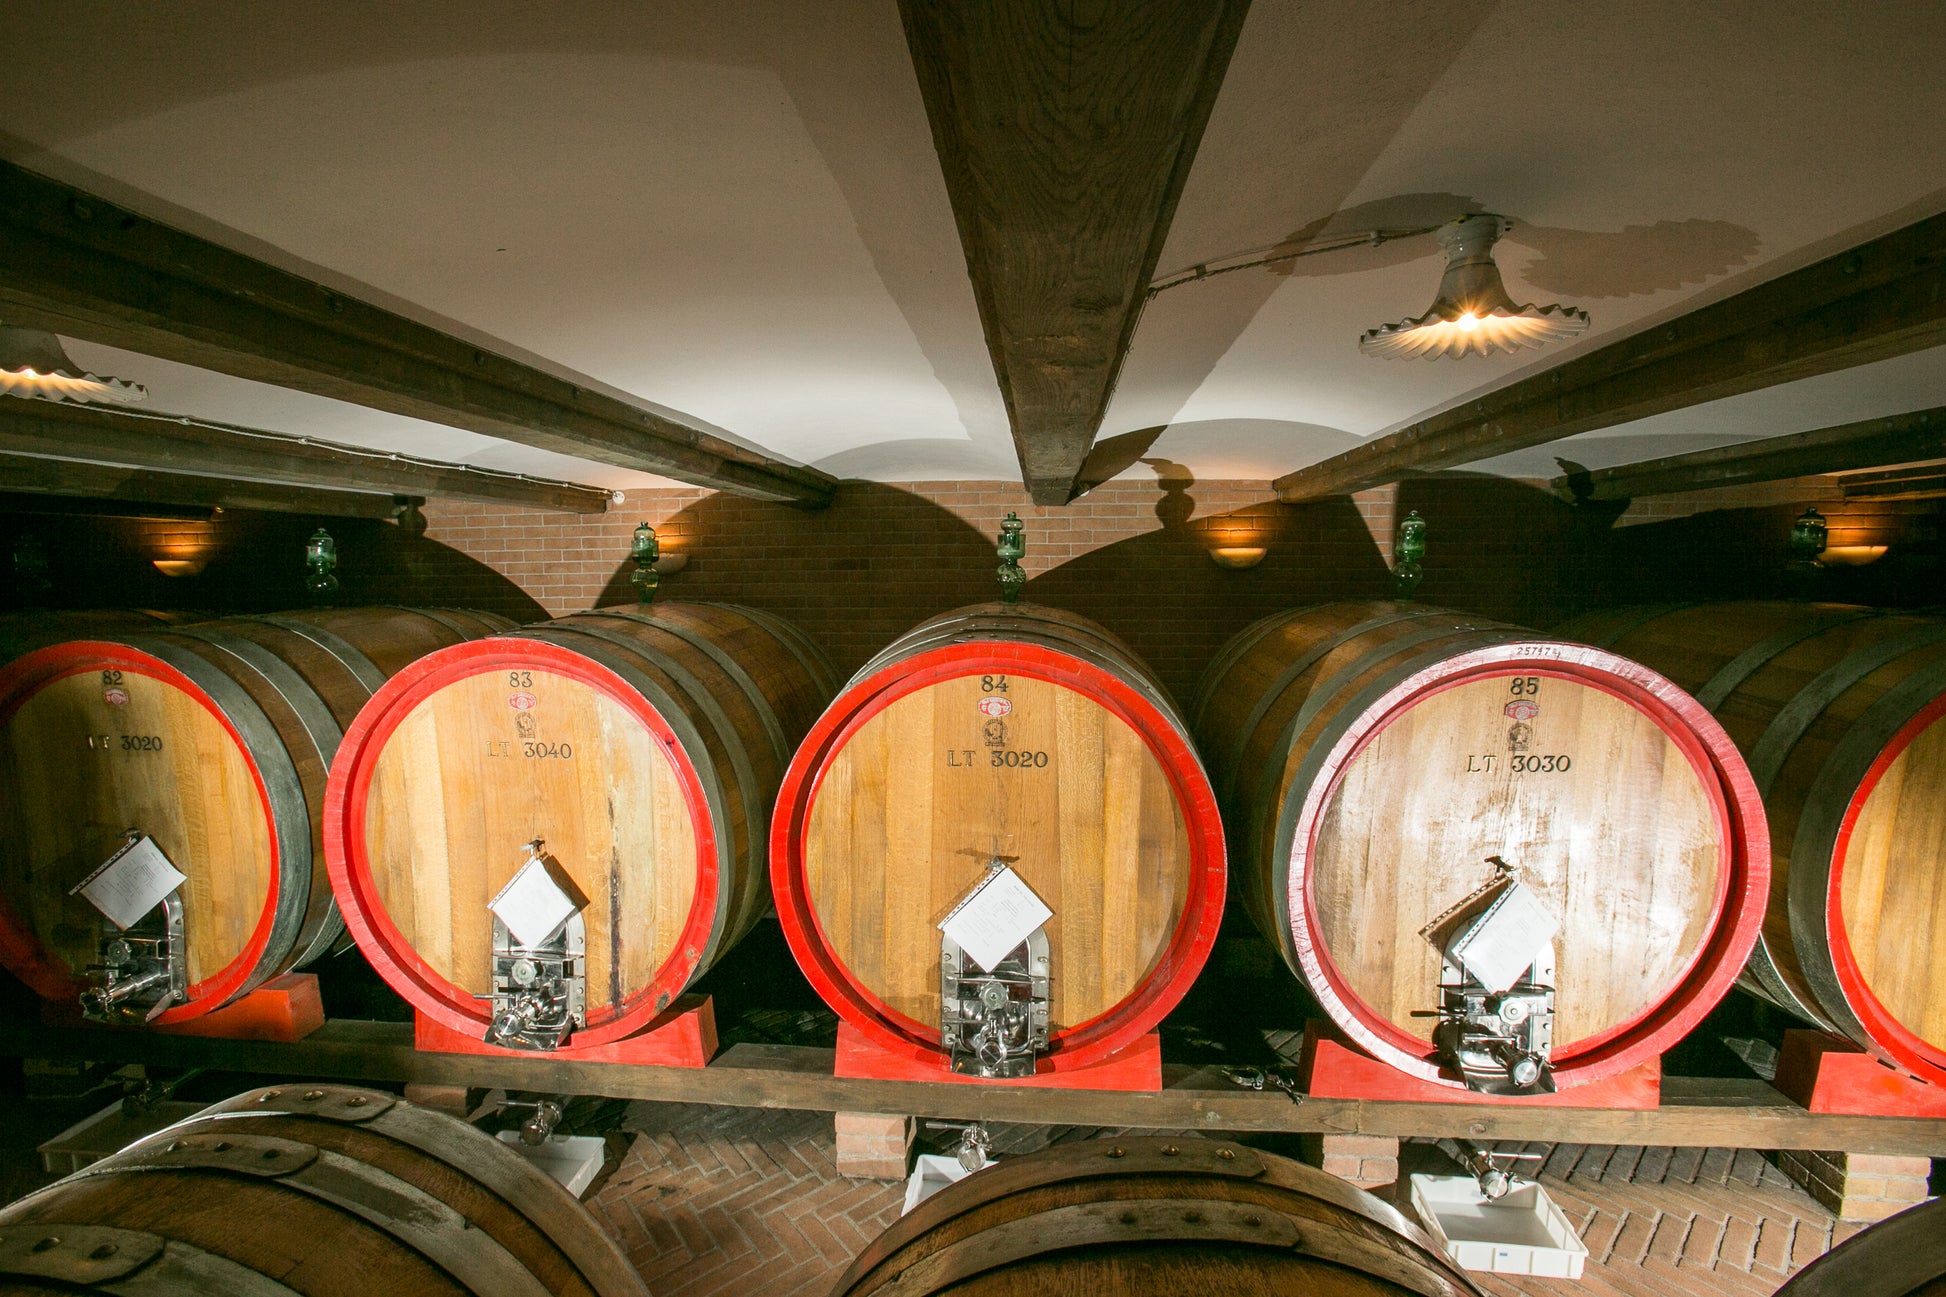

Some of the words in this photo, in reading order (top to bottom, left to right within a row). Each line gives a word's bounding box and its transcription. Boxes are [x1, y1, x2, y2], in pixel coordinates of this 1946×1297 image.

[102, 670, 123, 685] 82
[509, 671, 533, 688] 83
[981, 675, 1009, 693] 84
[1510, 677, 1540, 695] 85
[121, 735, 163, 751] 3020
[486, 740, 510, 757] LT
[524, 742, 572, 759] 3040
[947, 750, 976, 767] LT
[991, 750, 1049, 768] 3020
[1467, 754, 1497, 773] LT
[1512, 754, 1571, 773] 3030
